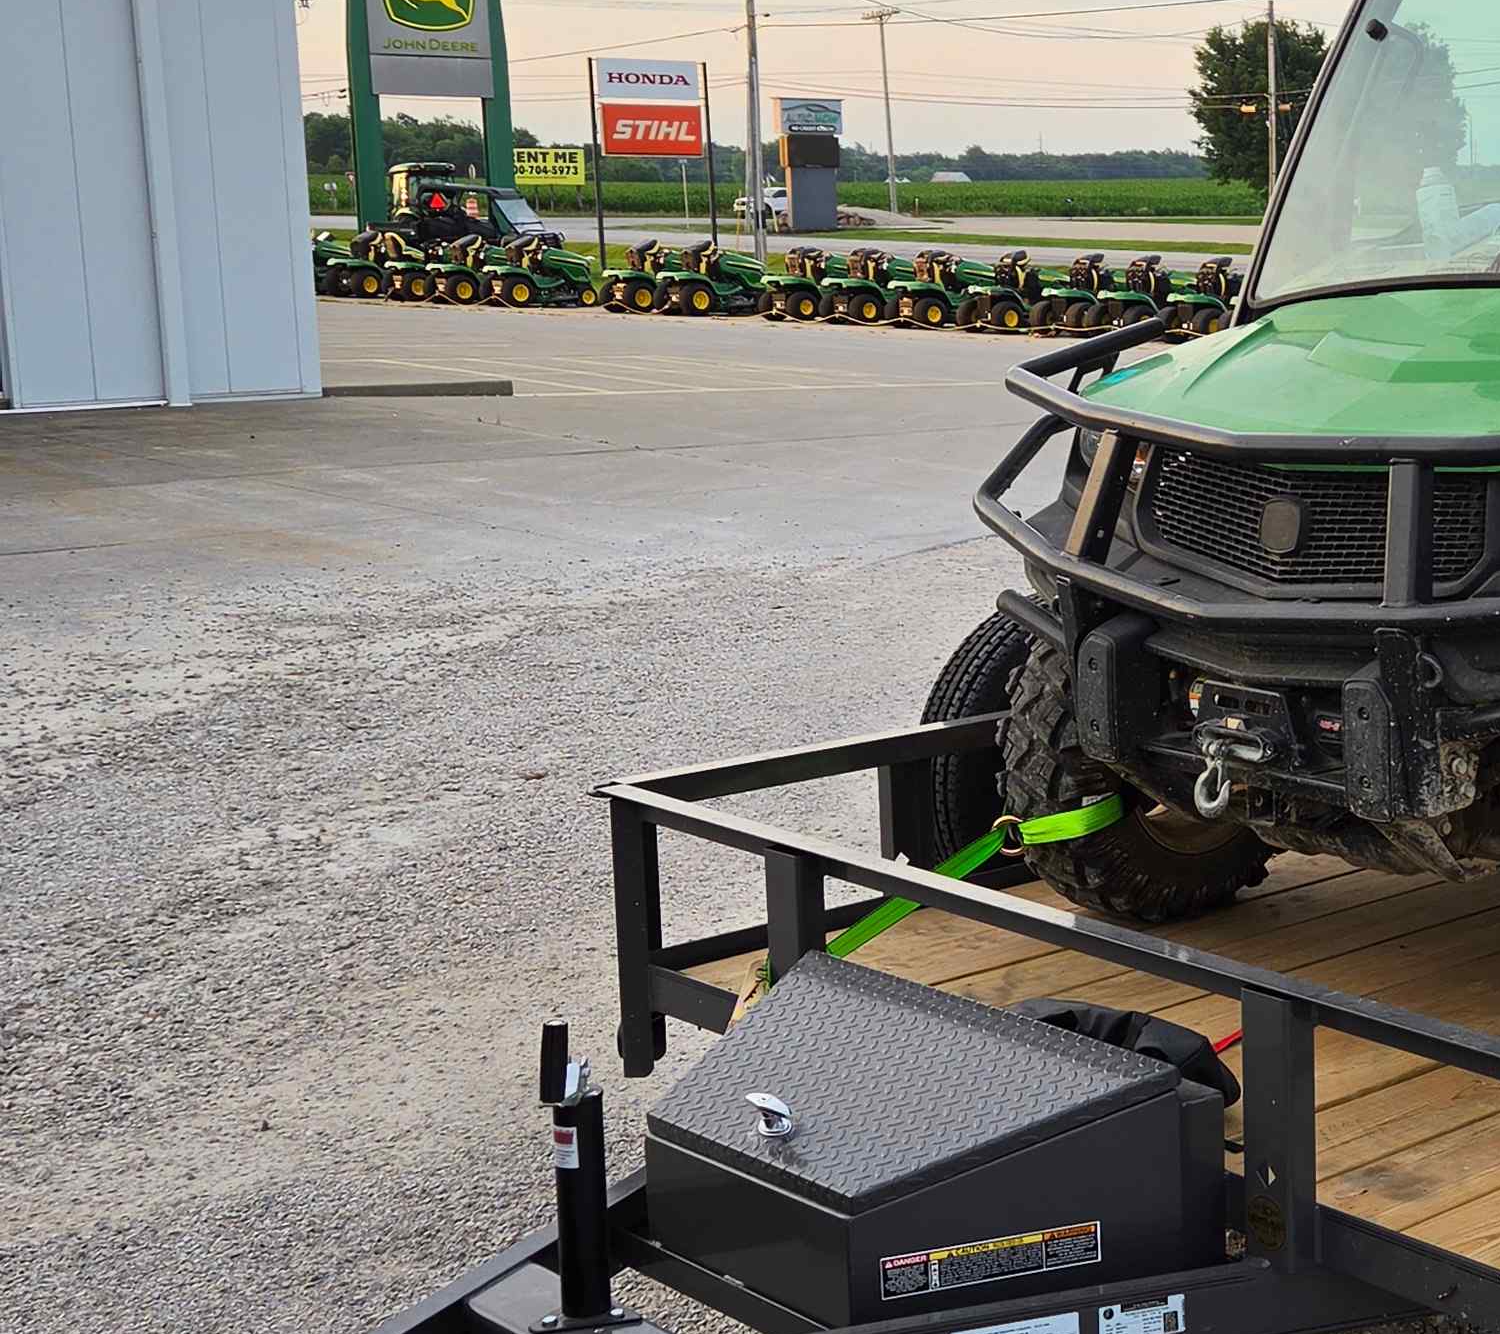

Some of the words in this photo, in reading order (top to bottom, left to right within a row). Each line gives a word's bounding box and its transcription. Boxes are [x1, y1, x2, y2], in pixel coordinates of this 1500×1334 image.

[383, 37, 426, 51] JOHN
[428, 38, 479, 53] DEERE
[607, 72, 691, 86] HONDA
[612, 119, 697, 142] STIHL
[513, 150, 550, 164] ENT
[554, 151, 579, 164] ME
[893, 1253, 928, 1268] DANGER
